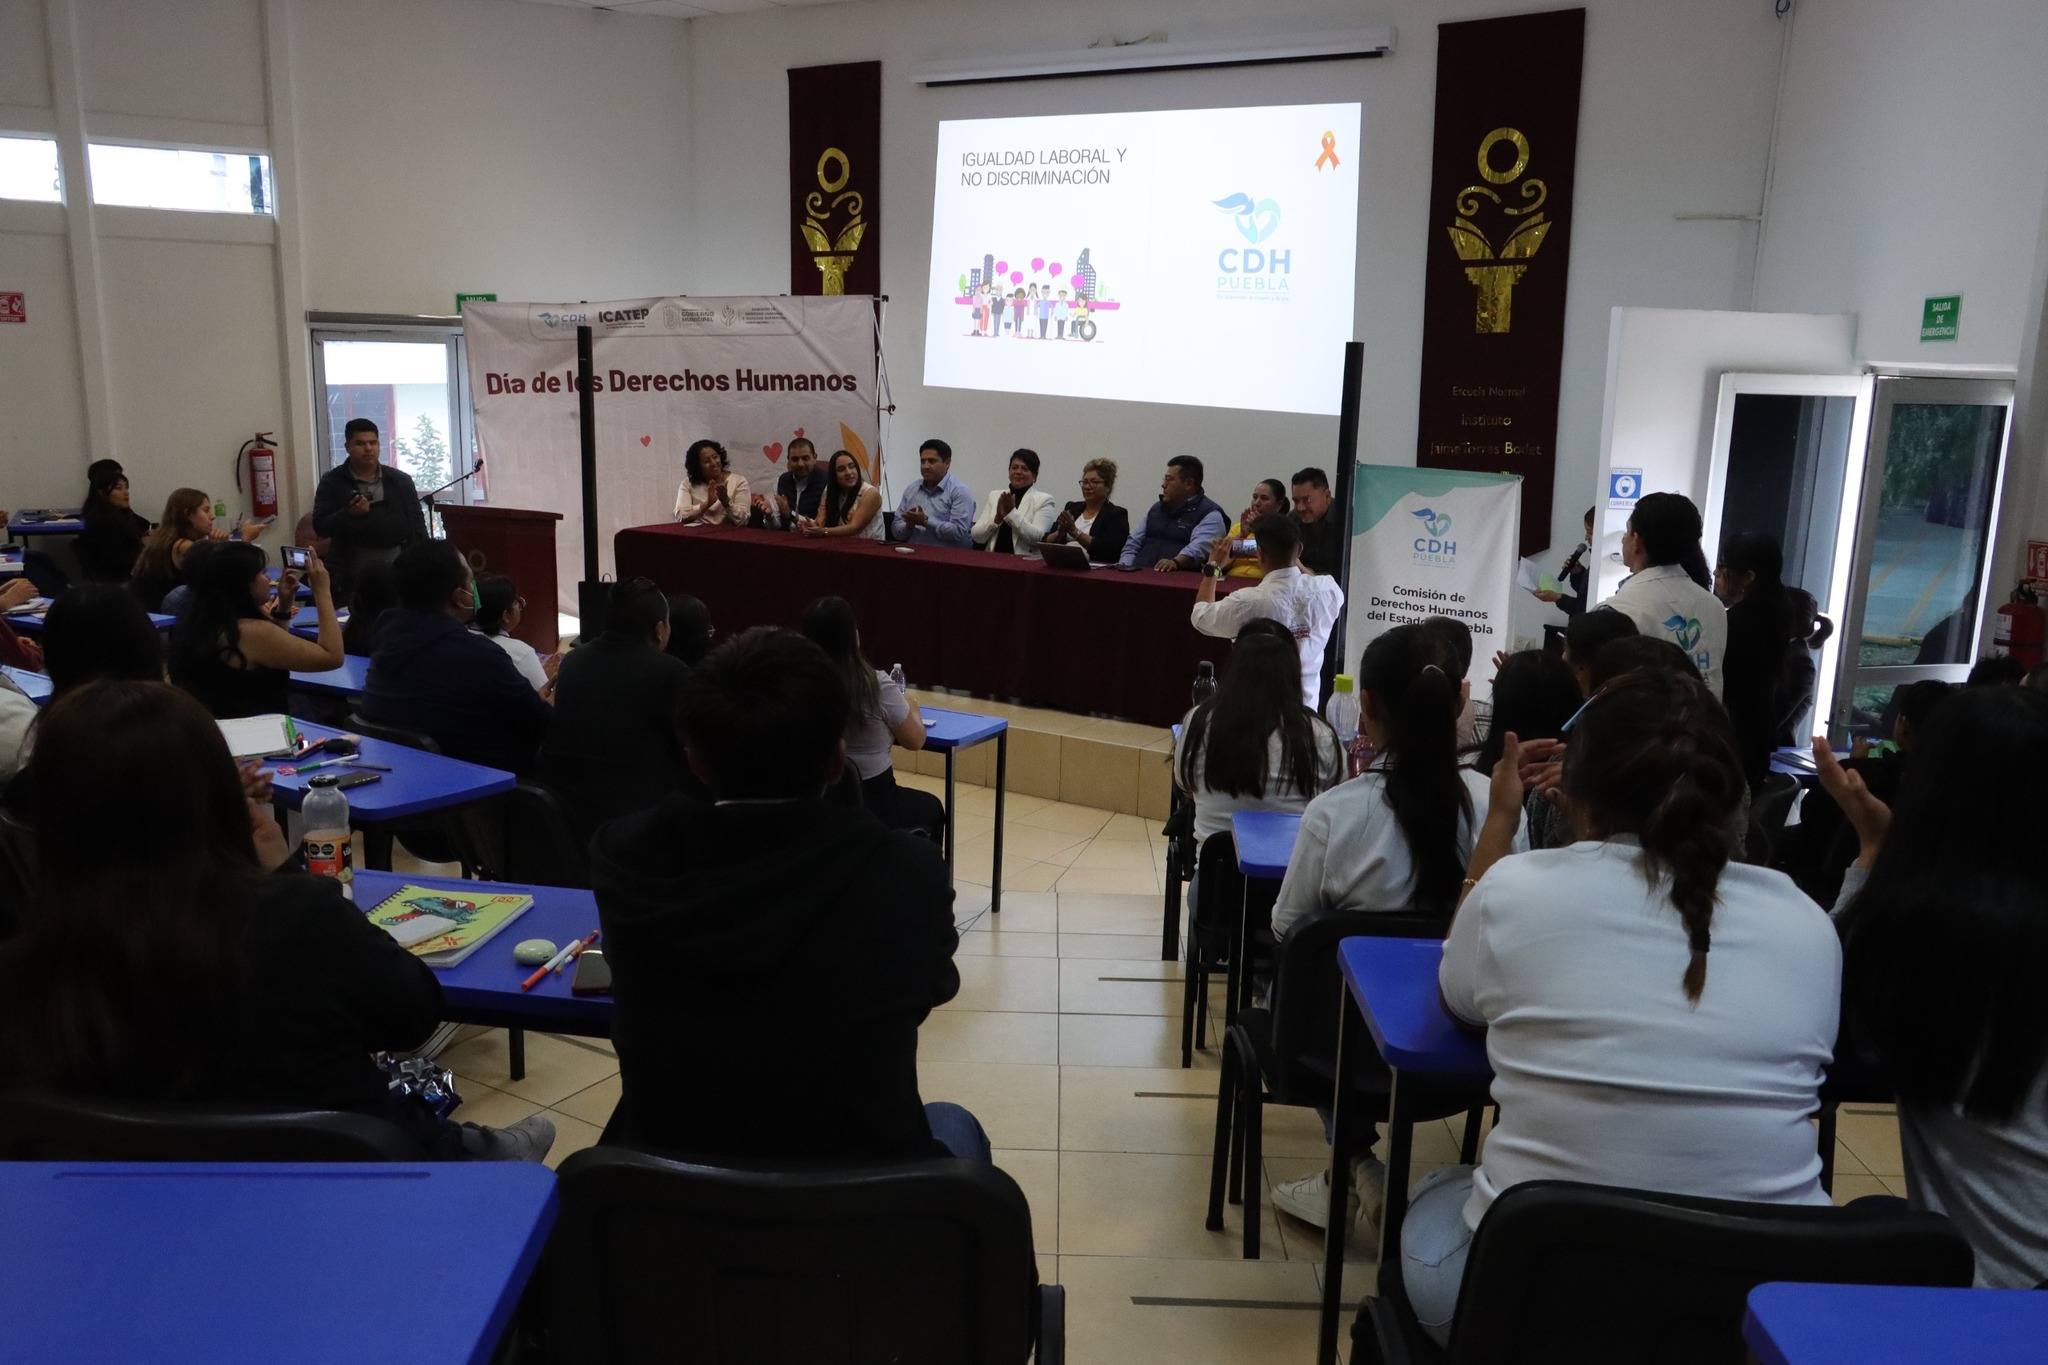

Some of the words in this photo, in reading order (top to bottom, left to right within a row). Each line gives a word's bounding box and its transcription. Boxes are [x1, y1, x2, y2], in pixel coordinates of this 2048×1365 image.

[962, 151, 1035, 167] IGUALDAD
[1040, 149, 1111, 165] LABORAL
[1116, 148, 1127, 162] Y
[961, 172, 982, 186] NO
[987, 166, 1110, 186] DISCRIMINACIÓN
[1218, 248, 1290, 274] CDH
[1217, 276, 1289, 290] PUEBLA
[1932, 302, 1951, 312] SALIDA
[561, 314, 587, 323] CDH
[598, 308, 649, 323] ICATEP
[1936, 315, 1944, 324] DE
[1921, 326, 1955, 337] EMERGENCIA
[486, 373, 526, 395] Día
[532, 371, 561, 393] de
[609, 369, 730, 392] Derechos
[735, 369, 857, 392] Humanos
[1452, 386, 1486, 397] Escuela
[1488, 386, 1526, 397] Normal
[1414, 538, 1457, 555] CDH
[1413, 552, 1456, 563] PUEBLA
[1392, 585, 1447, 601] Comisión
[1450, 592, 1466, 603] de
[1371, 597, 1426, 613] Derechos
[1428, 604, 1488, 620] Humanos
[1367, 610, 1386, 621] del
[1467, 623, 1493, 635] ebla
